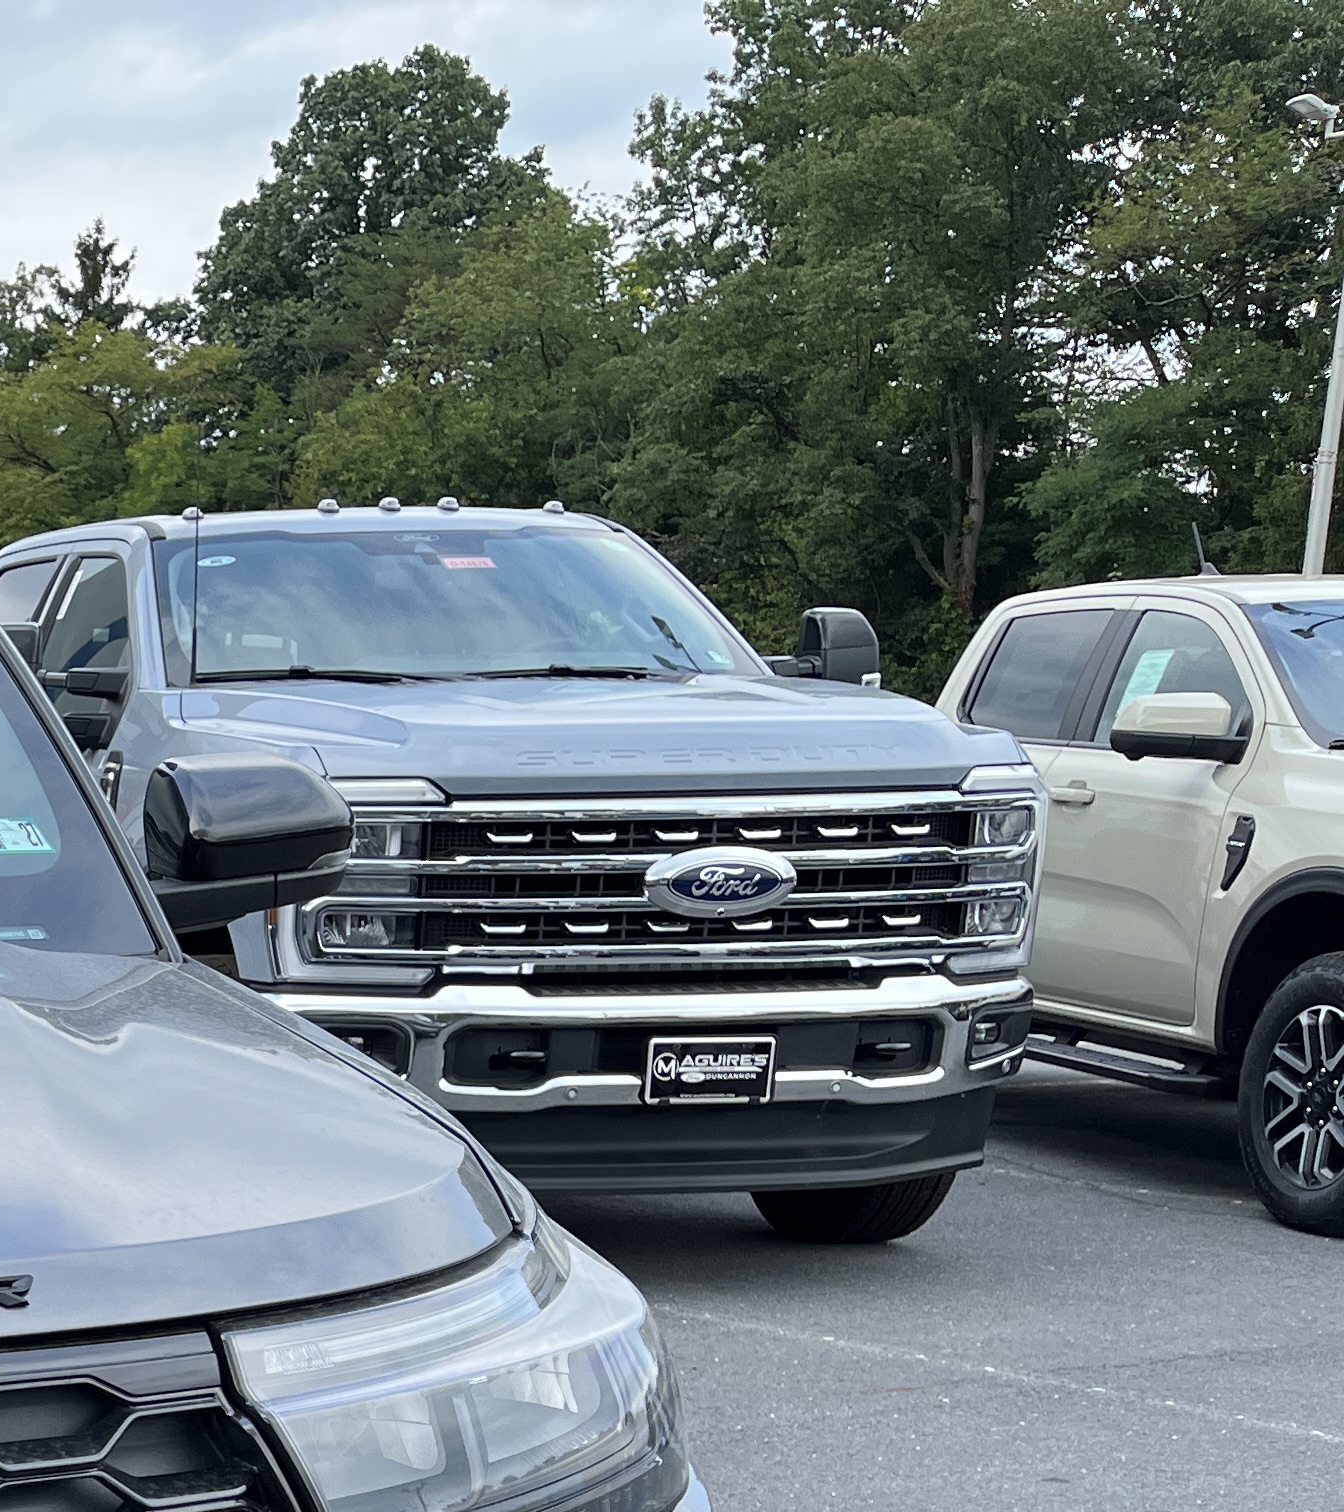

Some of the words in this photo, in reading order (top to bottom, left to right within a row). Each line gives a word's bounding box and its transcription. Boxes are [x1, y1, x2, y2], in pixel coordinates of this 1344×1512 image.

[514, 746, 737, 766] SUPER
[749, 743, 902, 762] DUTY
[690, 866, 762, 897] Ford
